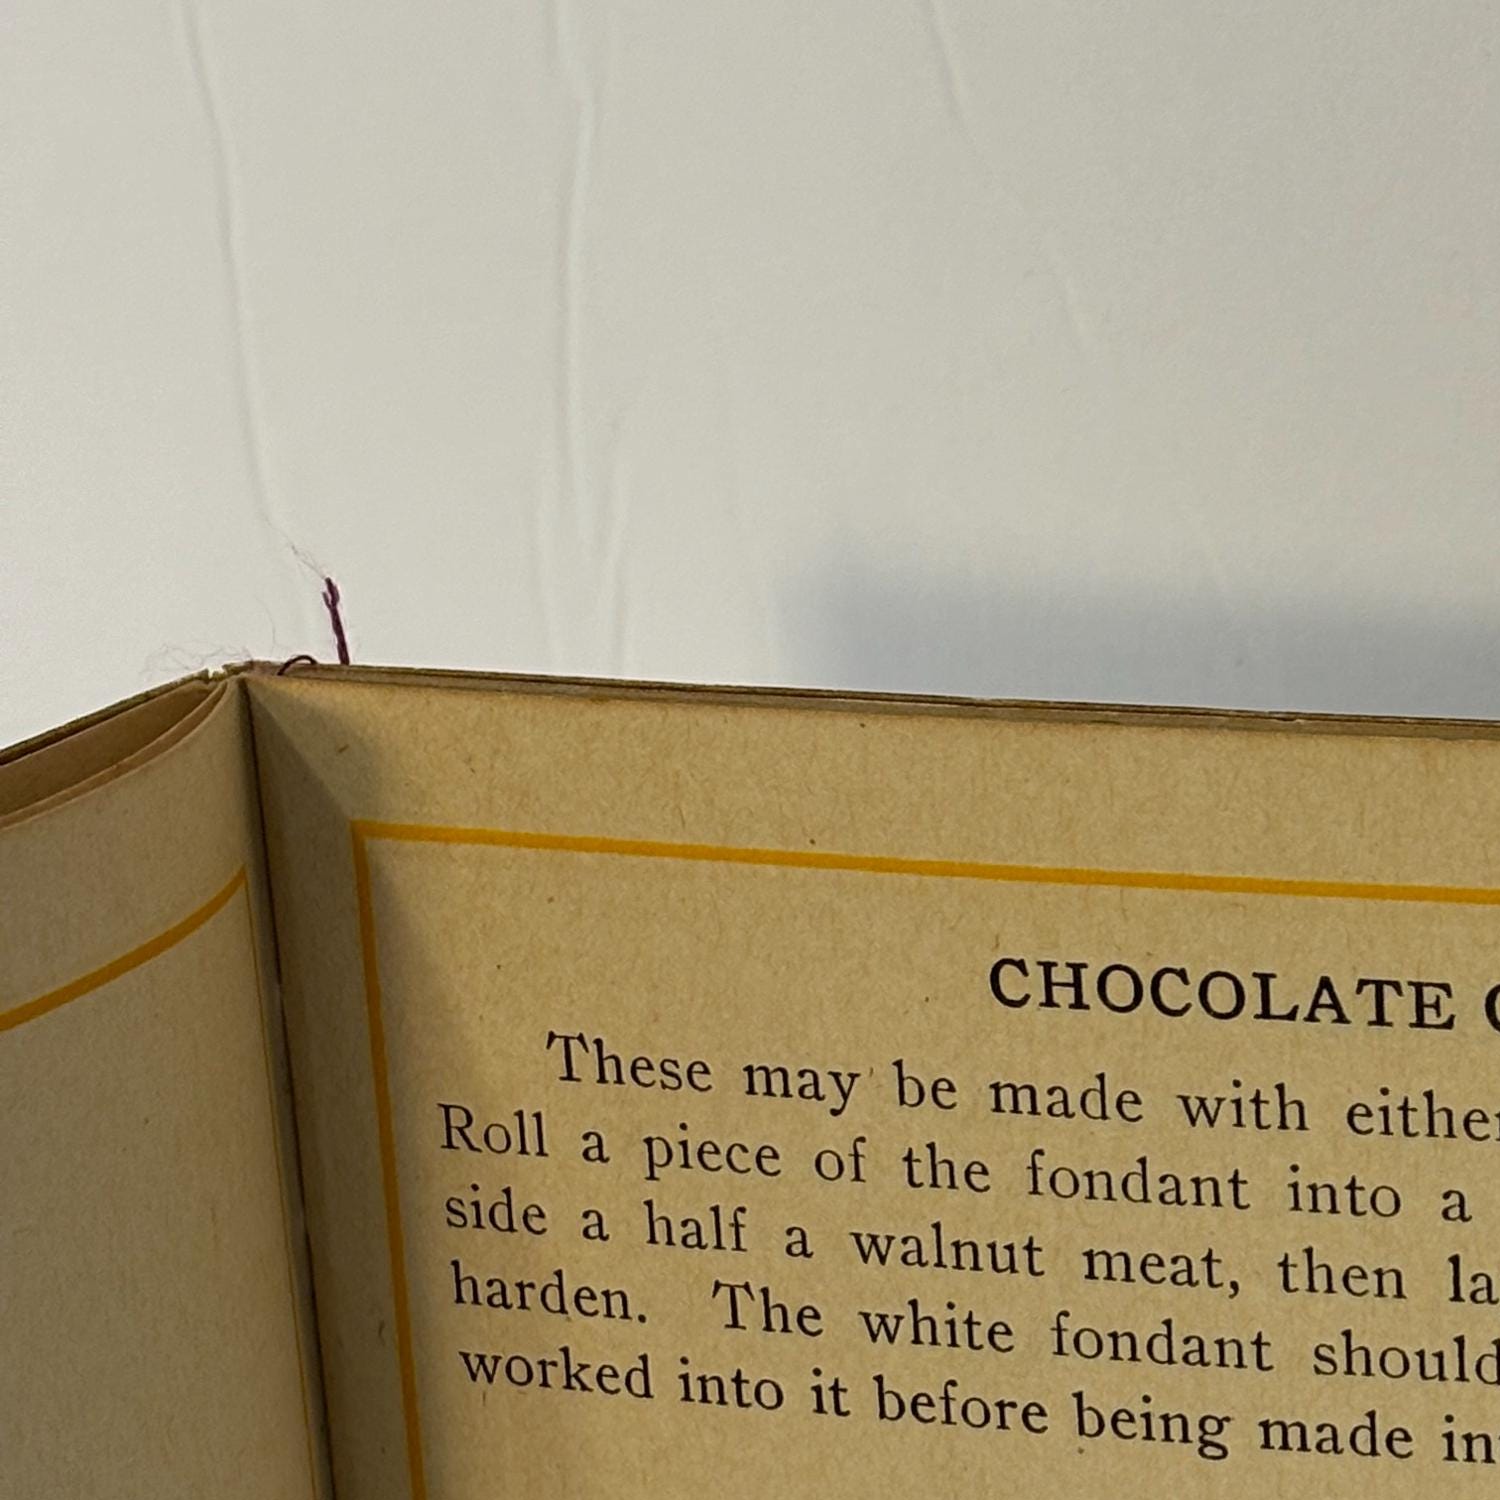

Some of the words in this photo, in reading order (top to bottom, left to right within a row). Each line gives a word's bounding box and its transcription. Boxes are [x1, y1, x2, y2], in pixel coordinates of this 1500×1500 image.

[989, 957, 1457, 1031] CHOCOLATE
[545, 1030, 713, 1093] These
[742, 1064, 862, 1118] may
[891, 1058, 957, 1111] be
[988, 1071, 1144, 1123] made
[1175, 1078, 1310, 1132] with
[437, 1103, 549, 1158] Roll
[581, 1131, 611, 1164] a
[642, 1122, 782, 1182] piece
[814, 1135, 867, 1184] of
[901, 1141, 991, 1194] the
[1025, 1148, 1251, 1211] fondant
[1287, 1163, 1402, 1218] into
[1441, 1189, 1473, 1223] a
[445, 1183, 548, 1236] side
[581, 1209, 610, 1242] a
[642, 1198, 748, 1253] half
[785, 1226, 815, 1259] a
[848, 1220, 1045, 1277] walnut
[1081, 1247, 1240, 1300] meat,
[1276, 1245, 1408, 1300] then
[450, 1259, 647, 1324] harden.
[711, 1279, 824, 1338] The
[857, 1298, 1015, 1354] white
[1049, 1309, 1275, 1372] fondant
[458, 1345, 655, 1400] worked
[677, 1356, 785, 1411] into
[810, 1367, 851, 1418] it
[872, 1373, 1049, 1435] before
[1071, 1390, 1234, 1461] being
[1257, 1409, 1414, 1460] made
